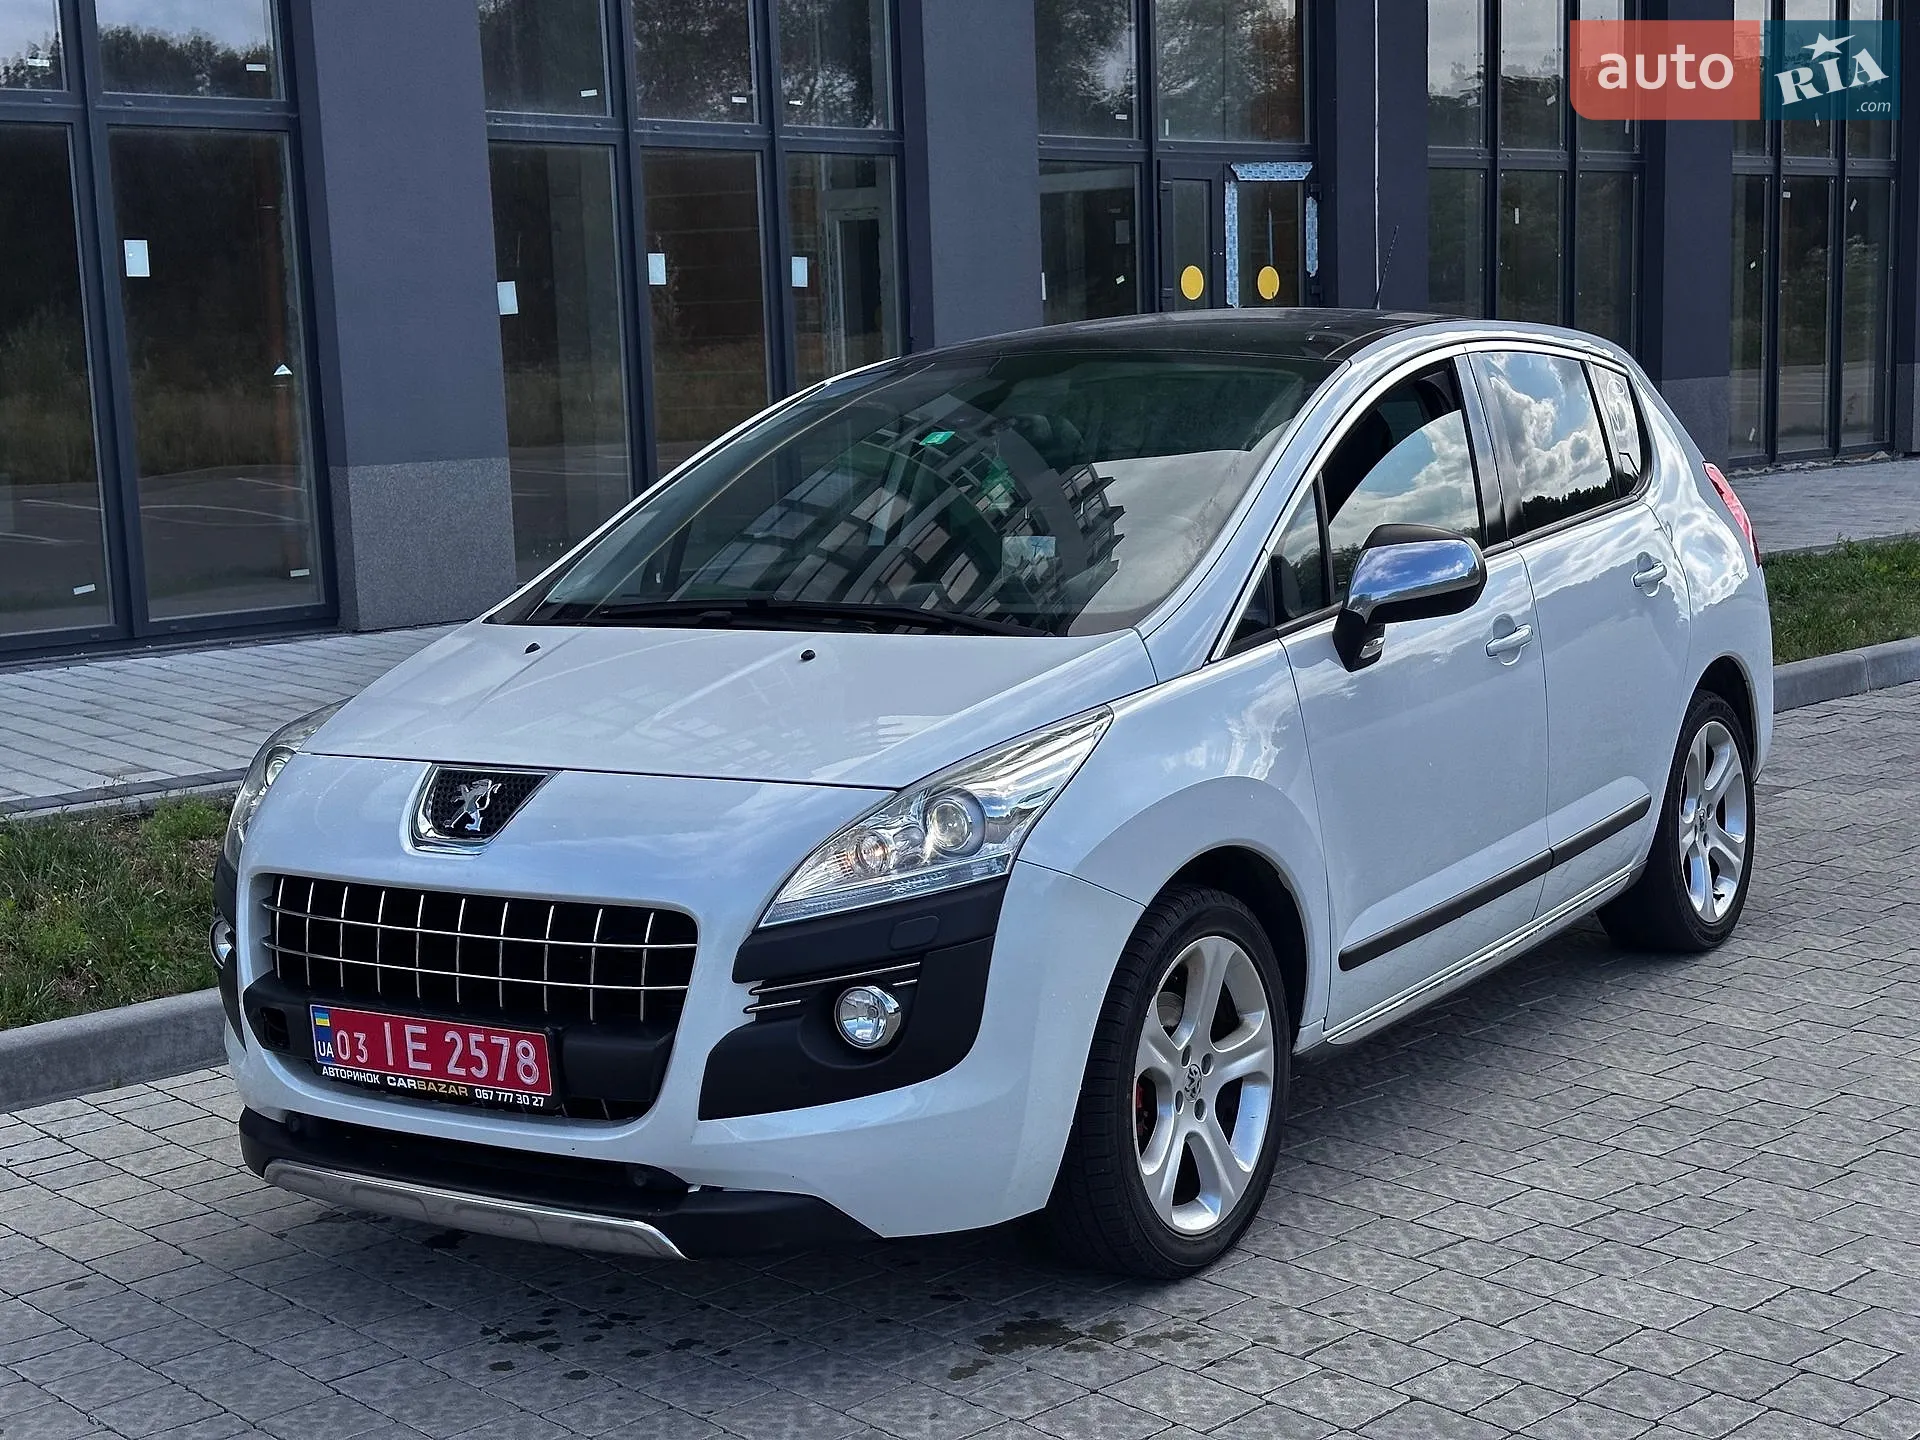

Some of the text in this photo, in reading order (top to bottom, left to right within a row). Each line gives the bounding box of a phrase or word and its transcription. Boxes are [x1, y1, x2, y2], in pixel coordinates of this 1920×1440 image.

[318, 1021, 540, 1085] UA 03 IE 2578
[322, 1065, 545, 1108] АВТОРИНОК CARBAZAR 067 777 30 27
